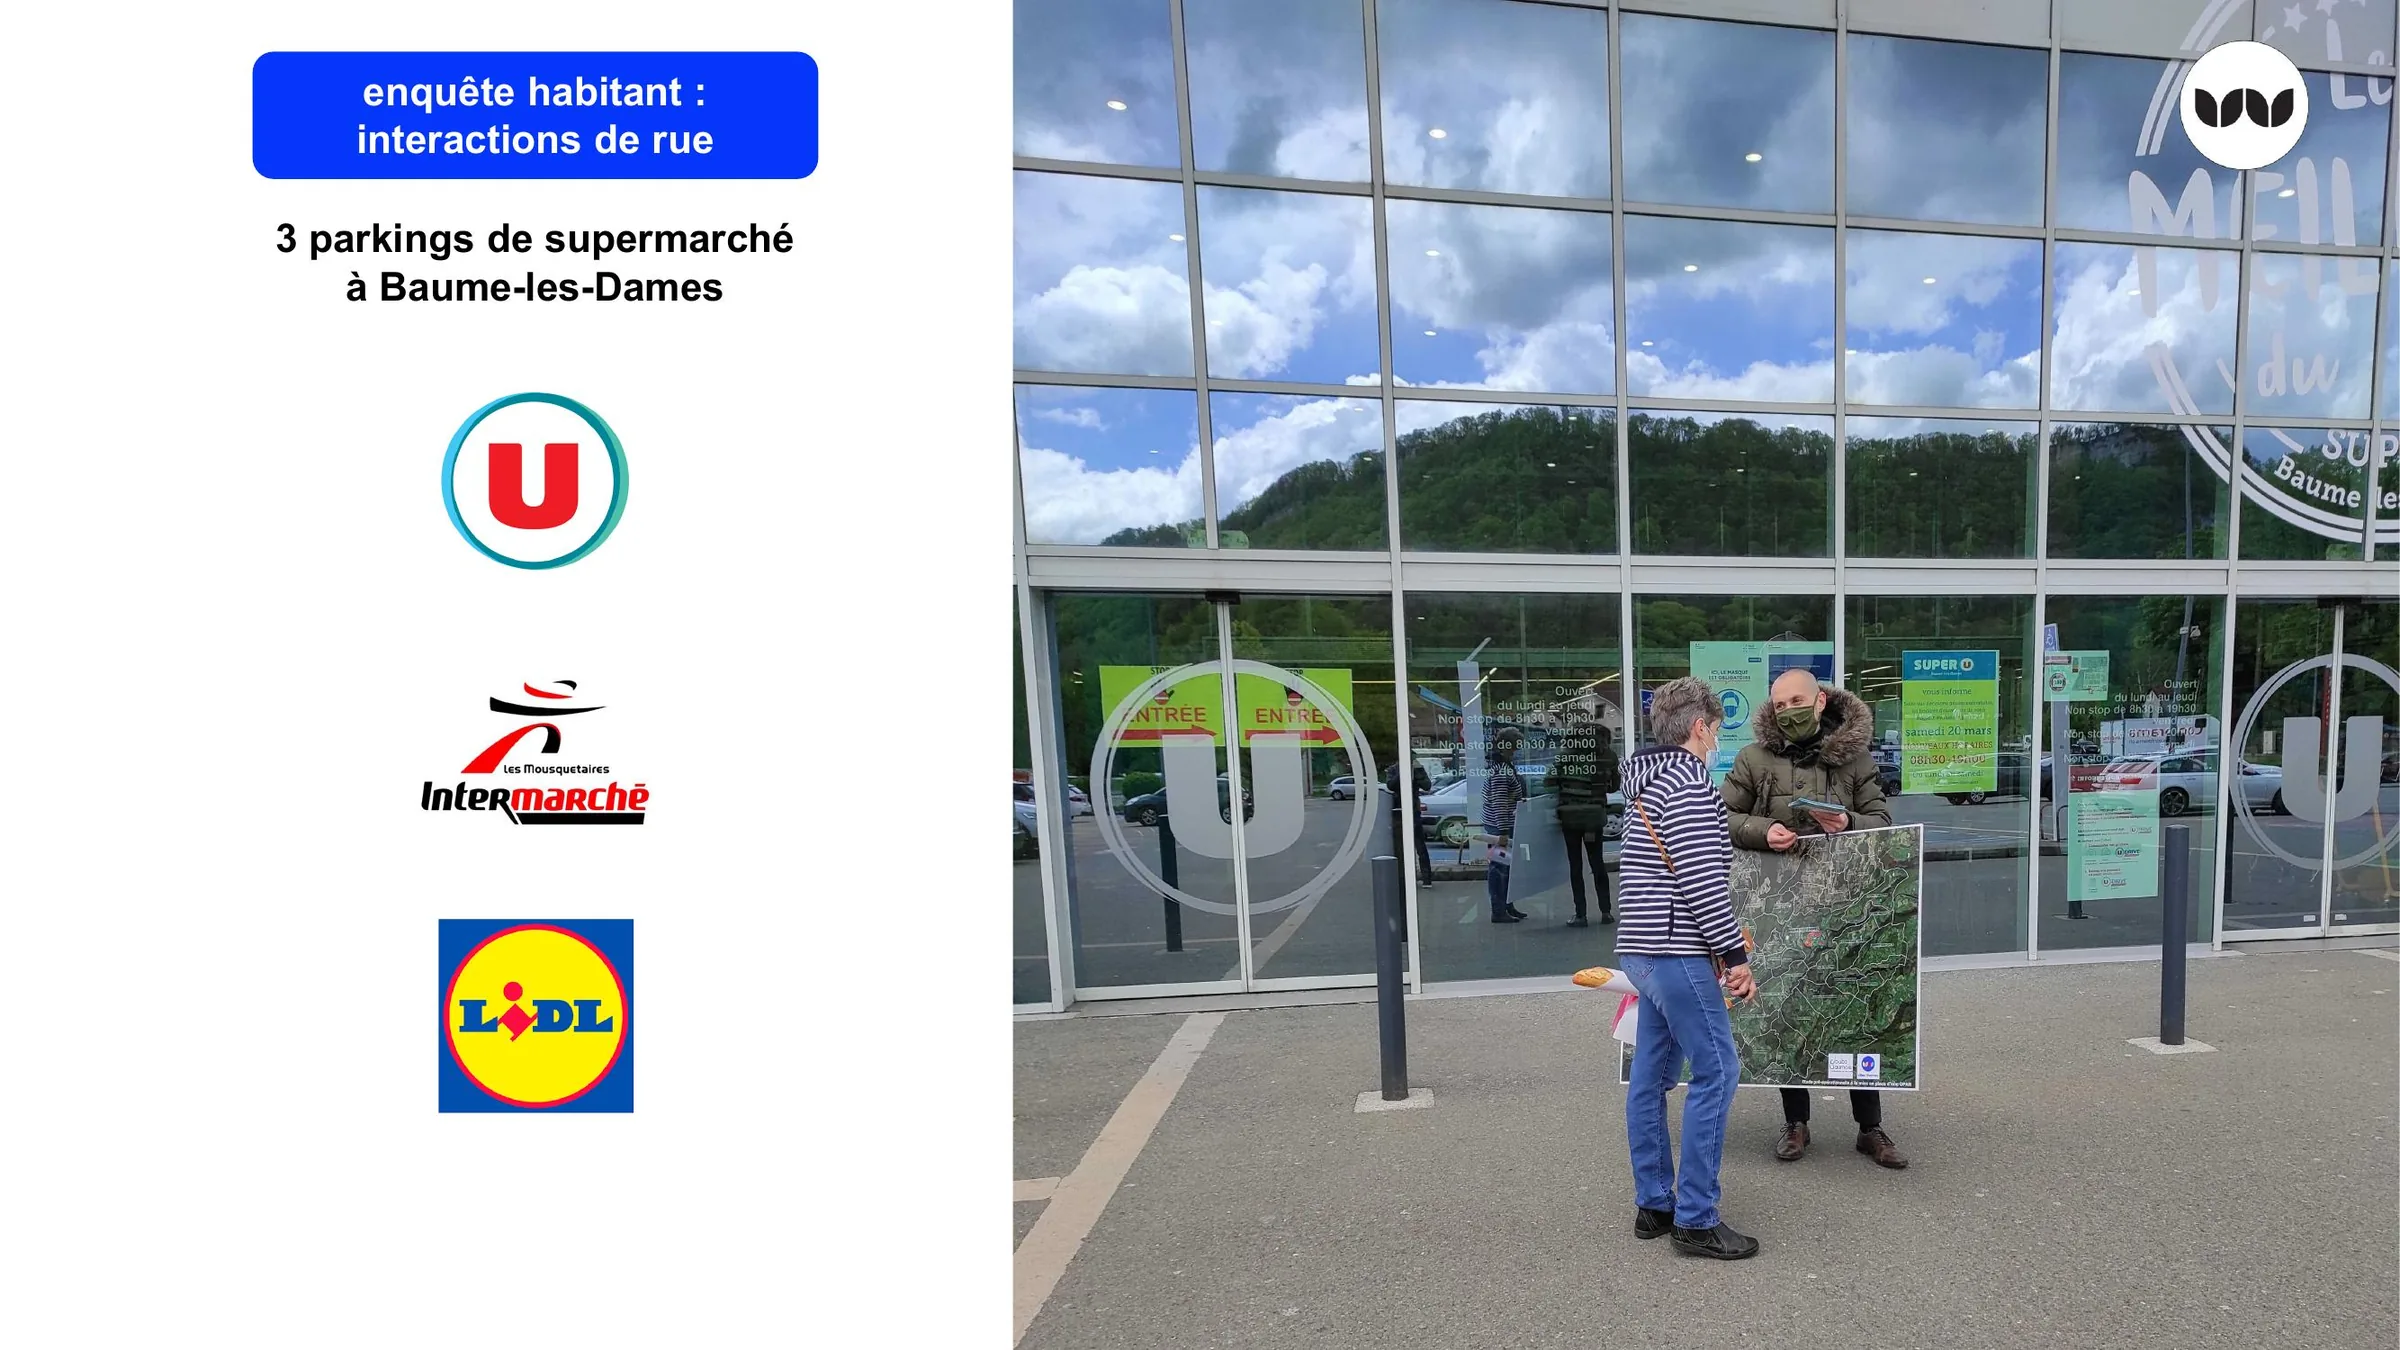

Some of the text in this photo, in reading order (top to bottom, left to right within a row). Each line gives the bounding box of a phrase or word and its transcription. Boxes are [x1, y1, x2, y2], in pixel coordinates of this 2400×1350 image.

[2274, 454, 2400, 510] Baume le
[1914, 659, 1958, 671] SUPER
[2164, 680, 2198, 689] Ouvert
[1555, 686, 1595, 696] Ouvert
[2115, 692, 2197, 703] du lundi au jeudi
[1497, 701, 1512, 710] du
[1517, 700, 1545, 710] lundi
[1567, 700, 1595, 712] jeudi
[2065, 705, 2086, 715] Non
[2089, 705, 2111, 716] stop
[2114, 704, 2126, 715] de
[2130, 704, 2154, 714] 8h30
[2168, 703, 2197, 714] 19h30
[1438, 713, 1595, 726] Non stop de 8h30 à 19h30
[1545, 726, 1596, 736] vendredi
[1906, 726, 1992, 736] samedi 20 mars
[2064, 729, 2084, 739] Non
[1439, 738, 1596, 752] Non stop de 8h30 à 20h00
[1555, 752, 1597, 762] samedi
[1911, 755, 1946, 765] 08h30
[1551, 764, 1558, 775] à
[1562, 765, 1597, 775] 19h30
[2282, 716, 2383, 823] U
[1162, 734, 1305, 859] U
